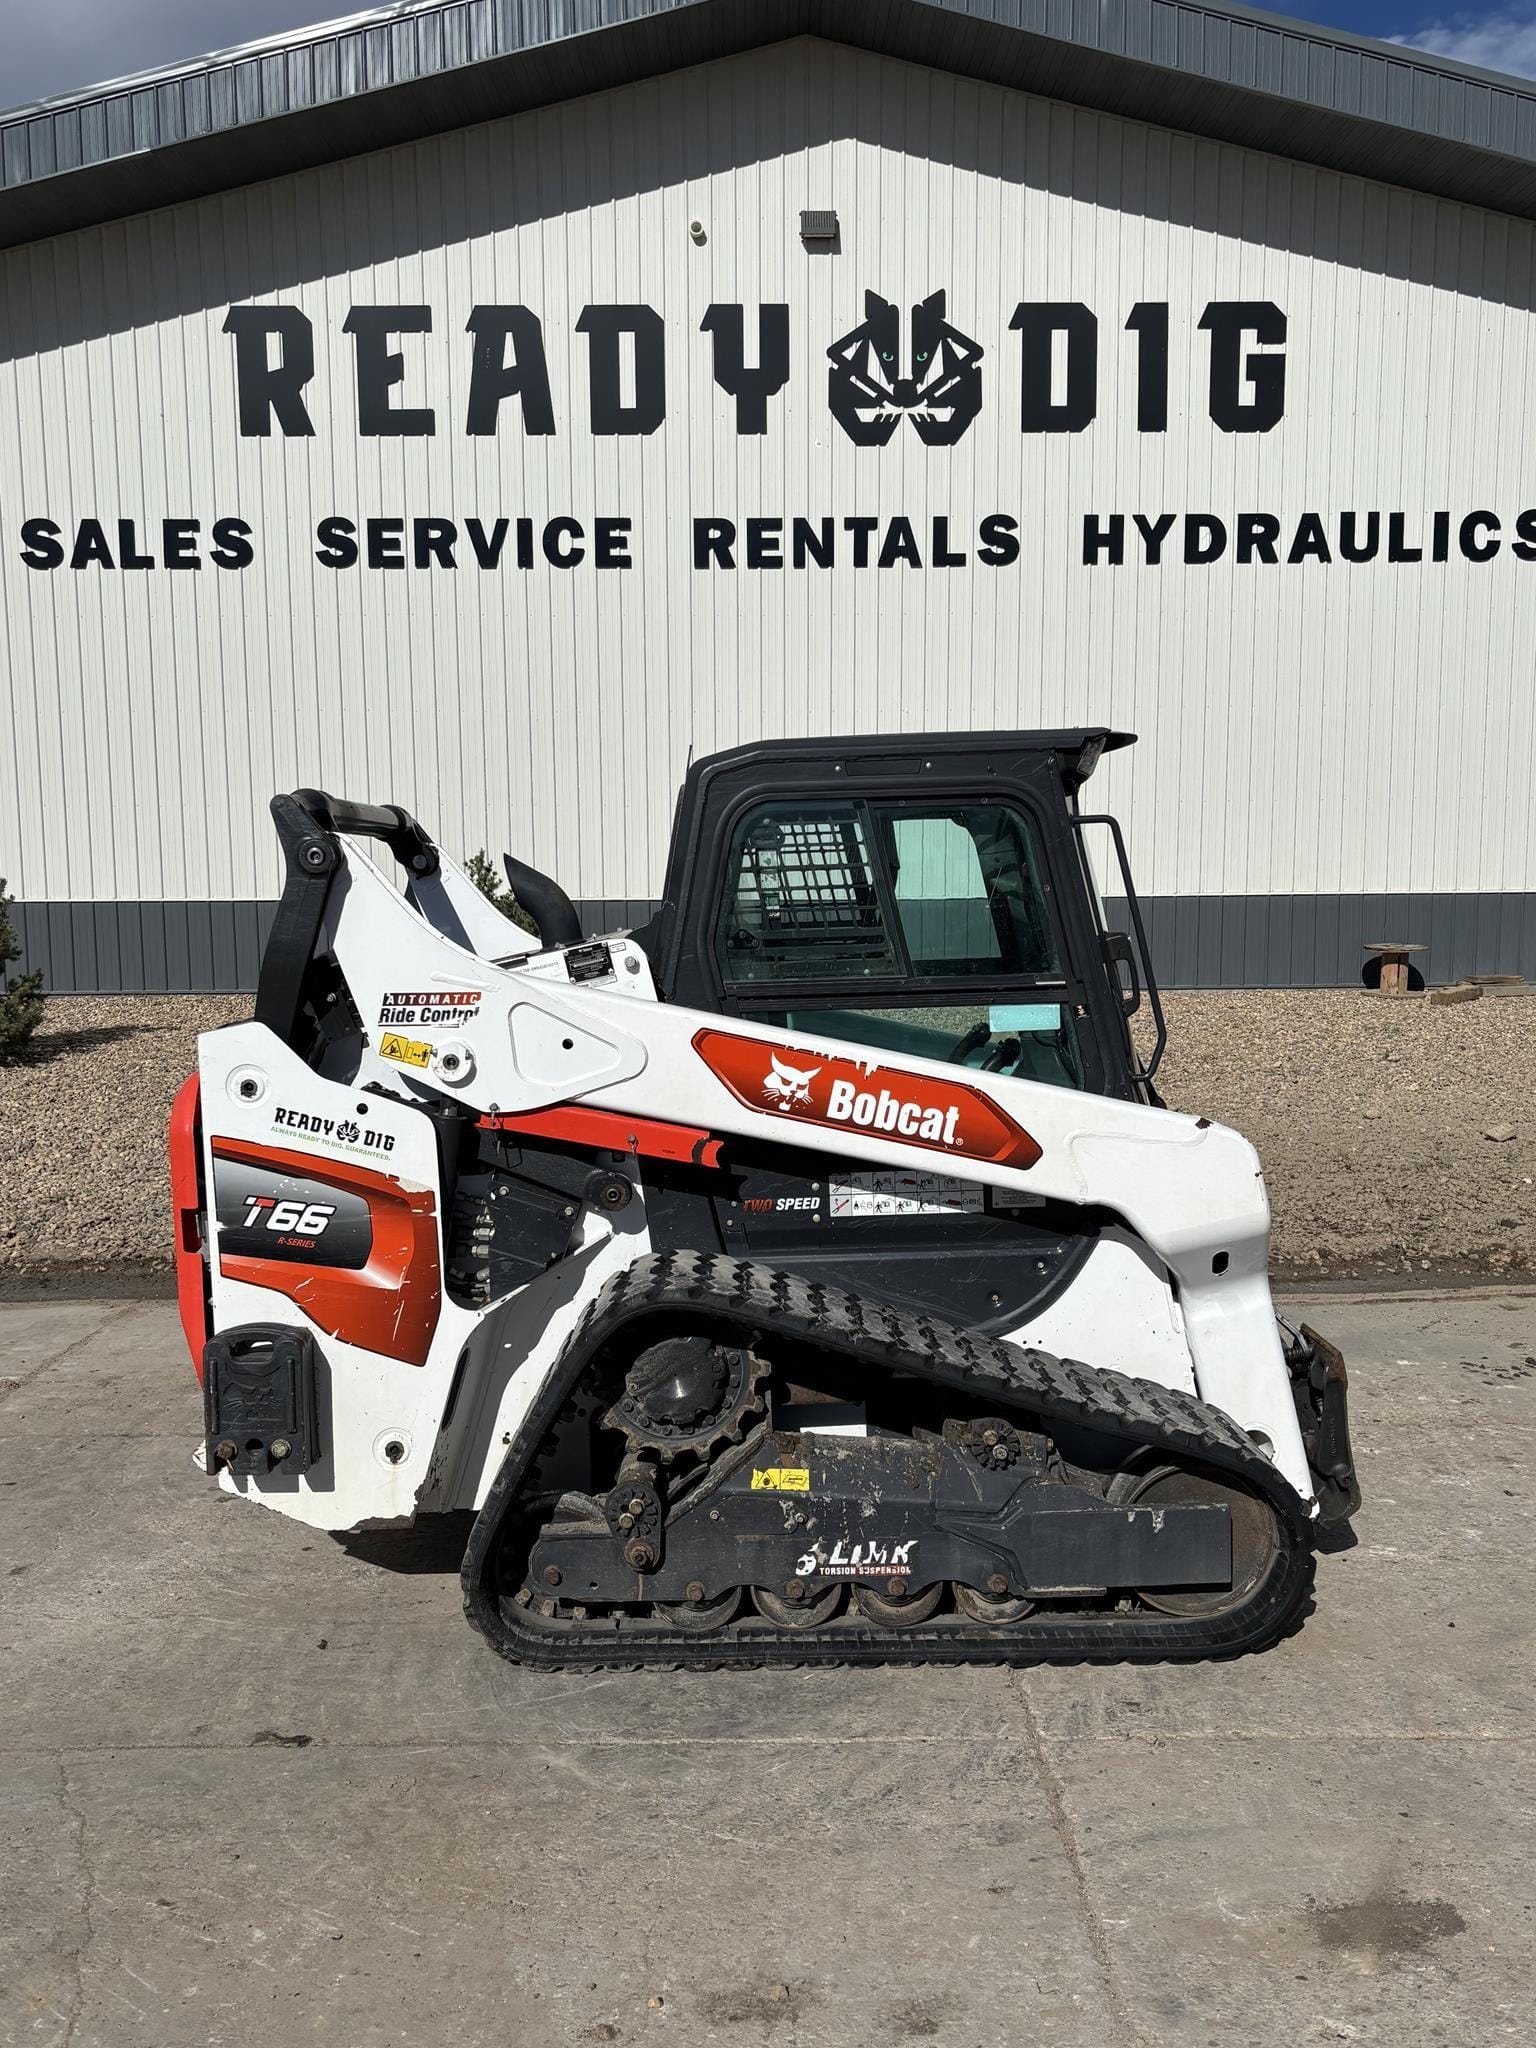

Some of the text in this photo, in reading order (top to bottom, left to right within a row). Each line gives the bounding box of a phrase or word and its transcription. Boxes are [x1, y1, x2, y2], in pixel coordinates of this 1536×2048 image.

[222, 301, 1288, 437] READY DIG
[20, 517, 254, 571] SALES
[316, 516, 632, 570] SERVICE
[694, 513, 1020, 570] RENTALS
[378, 1007, 415, 1024] Ride
[386, 993, 478, 1005] AUTOMATIC
[274, 1107, 396, 1151] READY DIG
[826, 1079, 960, 1145] Bobcat
[271, 1126, 297, 1137] ALWAYS
[297, 1132, 320, 1143] READY
[321, 1138, 330, 1146] TO
[345, 1144, 391, 1161] GUARANTEED.
[243, 1196, 337, 1236] T66
[743, 1196, 820, 1213] TWO SPEED
[277, 1236, 318, 1249] R-SERIES
[819, 1564, 912, 1575] TORSION SUSPENSION
